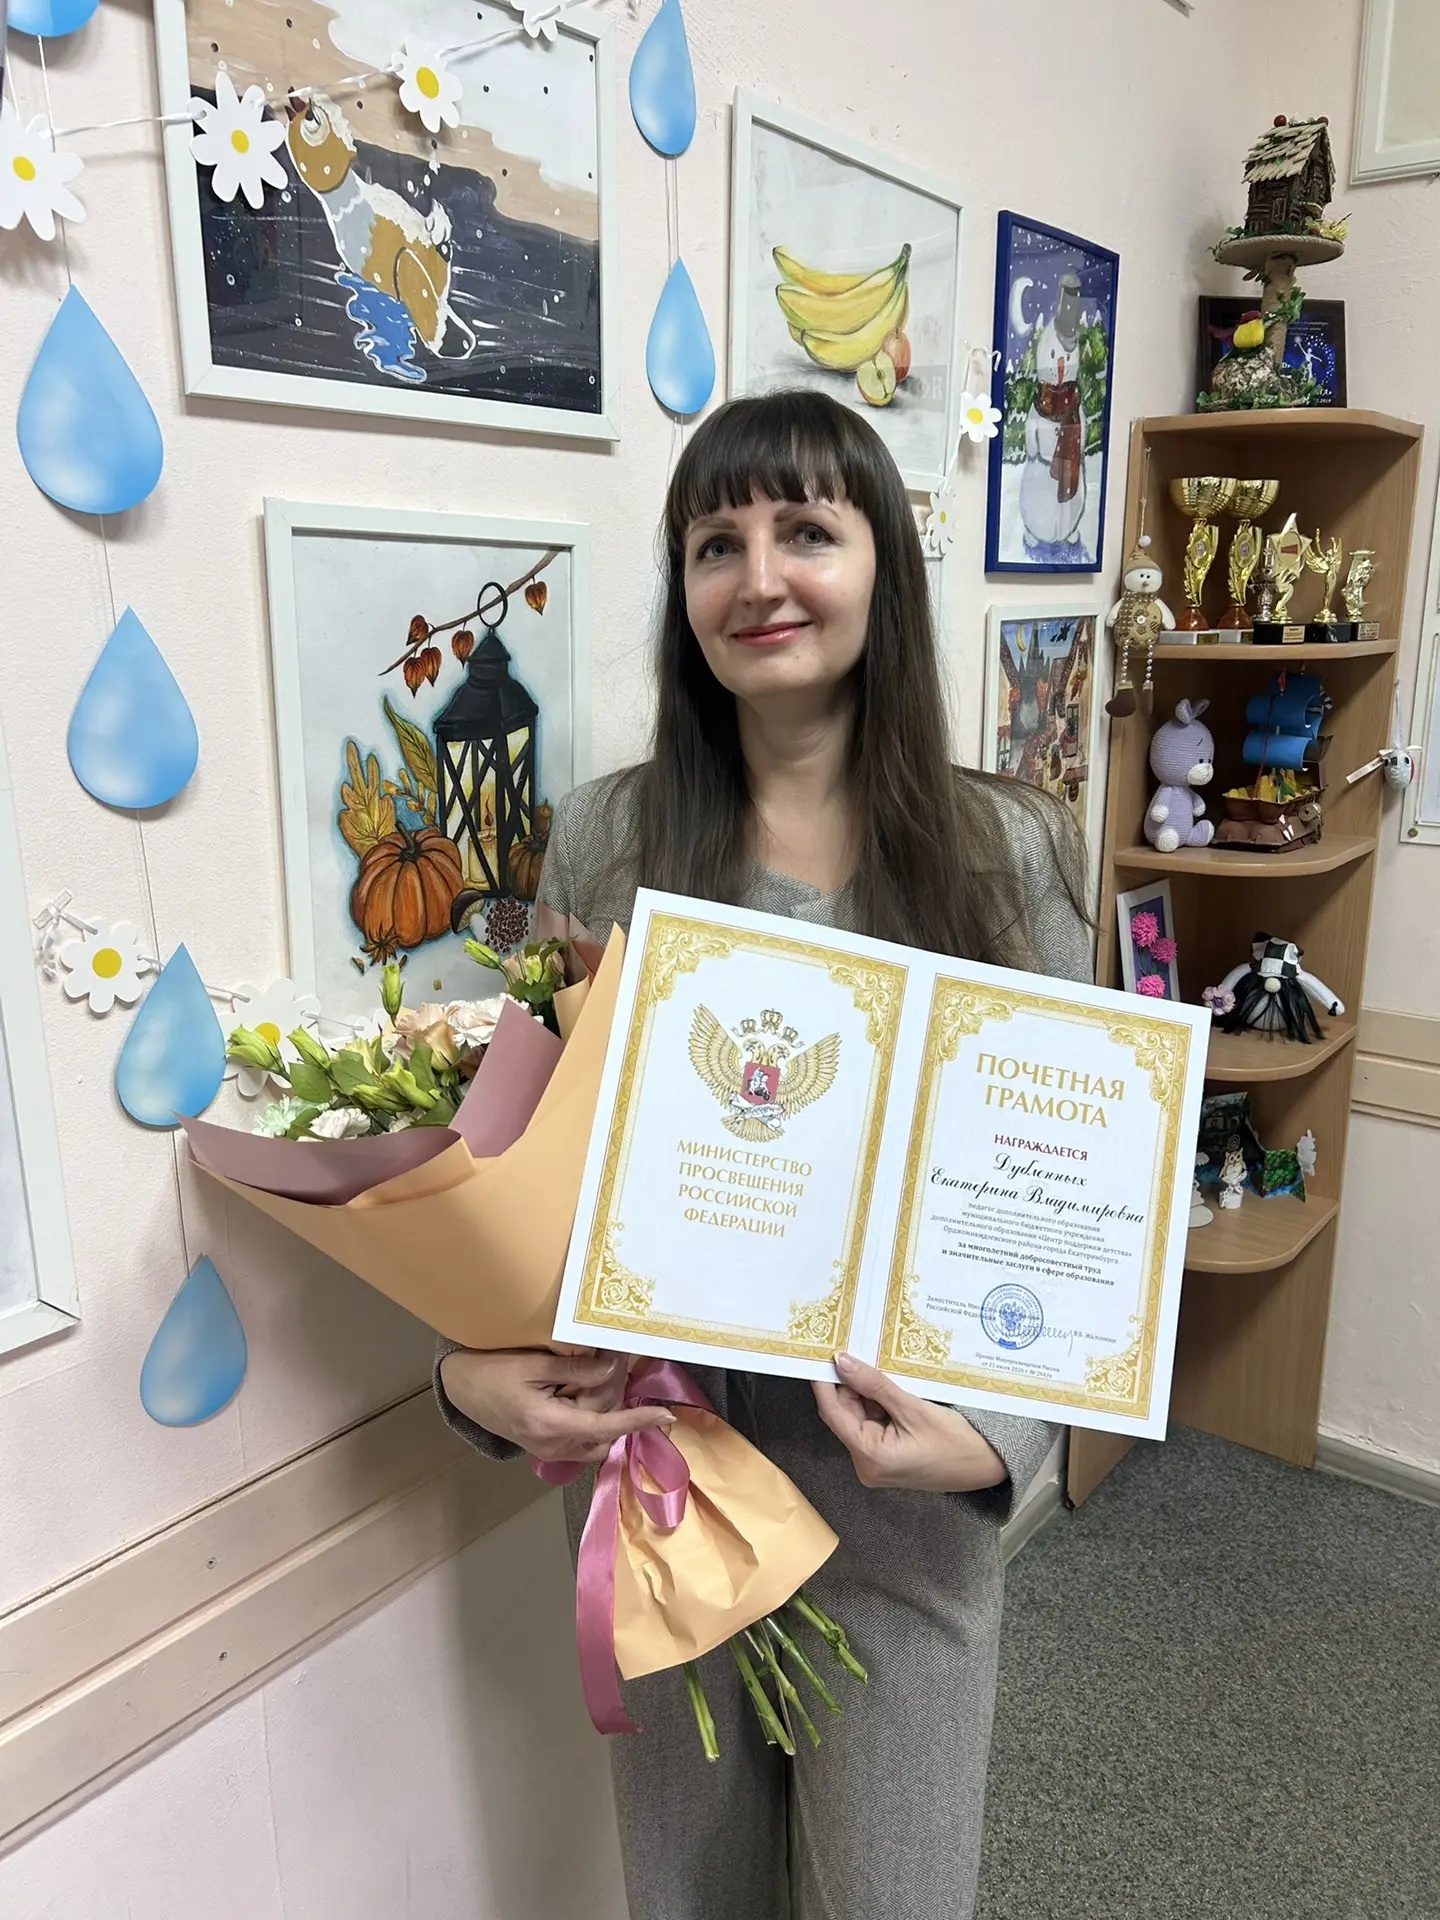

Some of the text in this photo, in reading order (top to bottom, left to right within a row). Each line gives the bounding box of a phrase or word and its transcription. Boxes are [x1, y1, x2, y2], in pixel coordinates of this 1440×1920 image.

[976, 1052, 1125, 1101] ПОЧЕТНАЯ
[985, 1084, 1107, 1129] ГРАМОТА
[676, 1139, 812, 1177] МИНИСТЕРСТВО
[994, 1133, 1088, 1161] НАГРАЖДАЕТСЯ
[678, 1161, 804, 1197] ПРОСВЕЩЕНИЯ
[930, 1167, 1144, 1224] Екатерина Владимировна
[678, 1183, 797, 1218] РОССИЙСКОЙ
[968, 1202, 1101, 1233] педагог дополнительного образования
[683, 1207, 785, 1238] ФЕДЕРАЦИИ
[930, 1214, 993, 1231] дополнительного
[992, 1225, 1037, 1240] образования
[958, 1241, 1102, 1275] за многолетний добросовестный труд
[1017, 1240, 1043, 1250] района
[1042, 1245, 1067, 1255] города
[948, 1250, 1004, 1266] значительные
[1004, 1260, 1035, 1272] заслуги
[1041, 1267, 1065, 1278] сфере
[1065, 1271, 1115, 1286] образования
